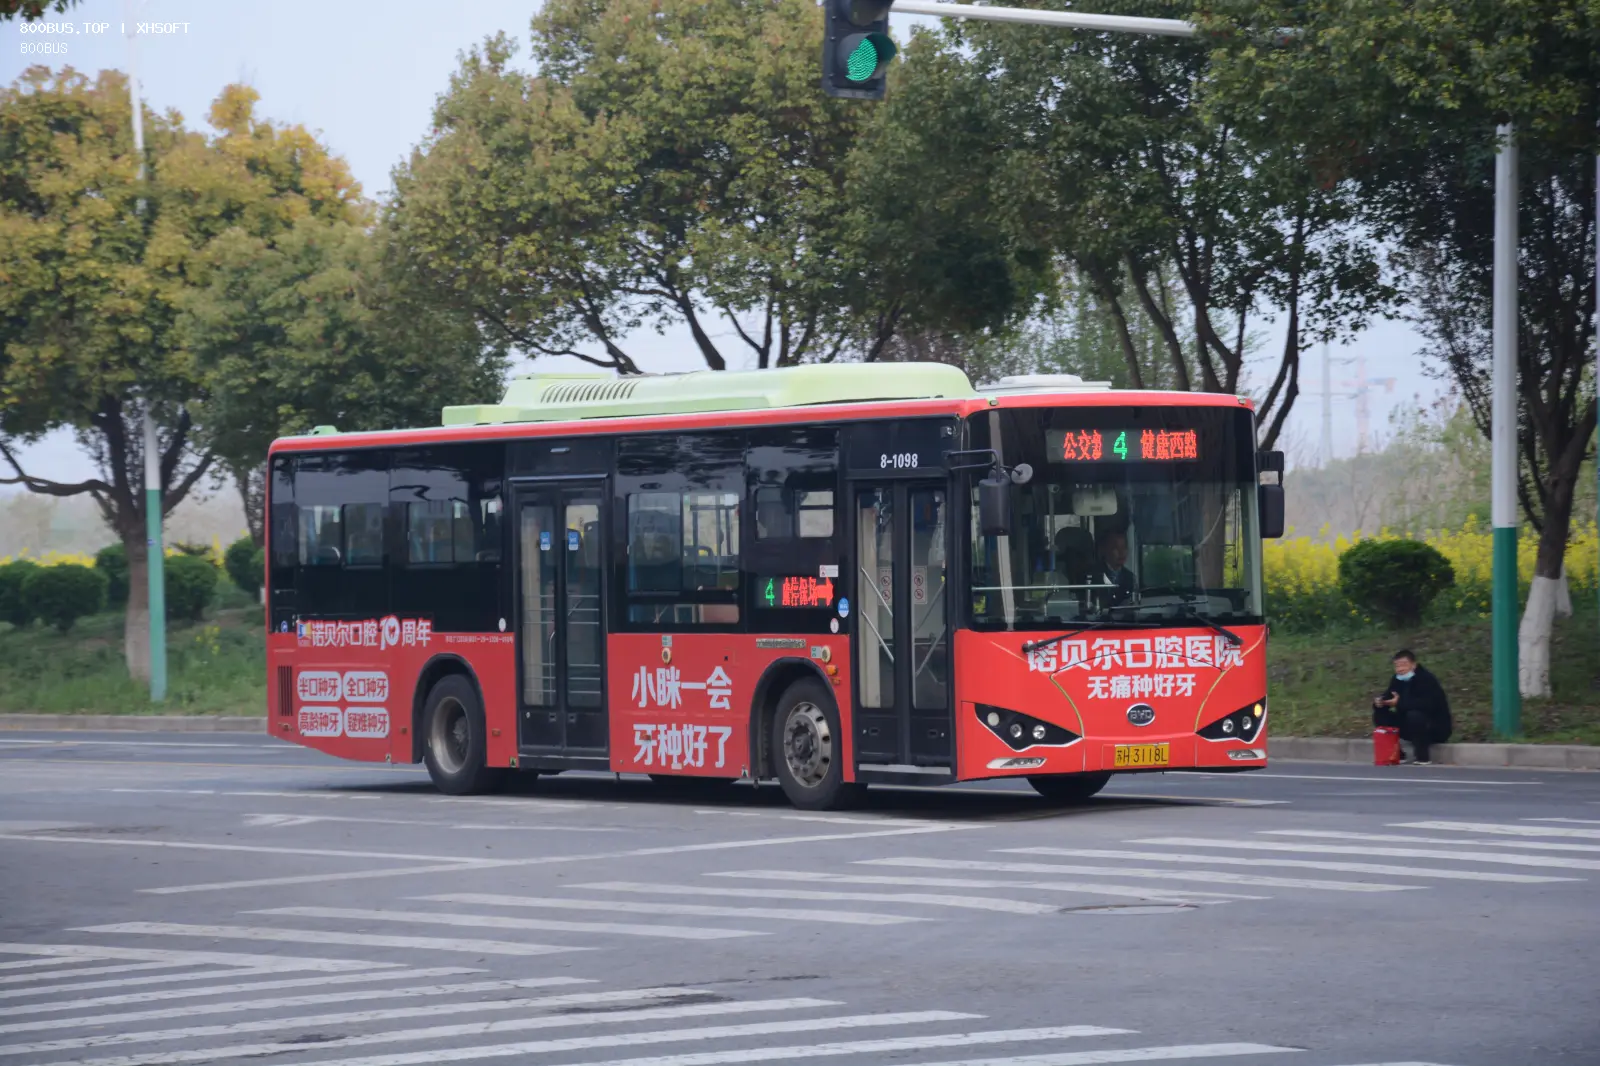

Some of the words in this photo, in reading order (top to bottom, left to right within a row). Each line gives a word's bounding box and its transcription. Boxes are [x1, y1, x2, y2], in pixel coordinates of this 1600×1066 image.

[1113, 431, 1128, 460] 4
[1140, 429, 1197, 459] 健康西路
[880, 453, 918, 469] 8-1098
[765, 578, 775, 607] 4
[1024, 635, 1245, 672] 诺贝尔口腔医院
[299, 677, 339, 698] 半口种牙
[346, 677, 388, 698] 全口种牙
[632, 665, 732, 710] 小眯一会
[1086, 673, 1197, 699] 无痛种好牙
[299, 711, 340, 732] 高龄种牙
[347, 712, 388, 732] 疑难种牙
[1130, 709, 1152, 720] BYD
[633, 723, 732, 770] 牙种好了
